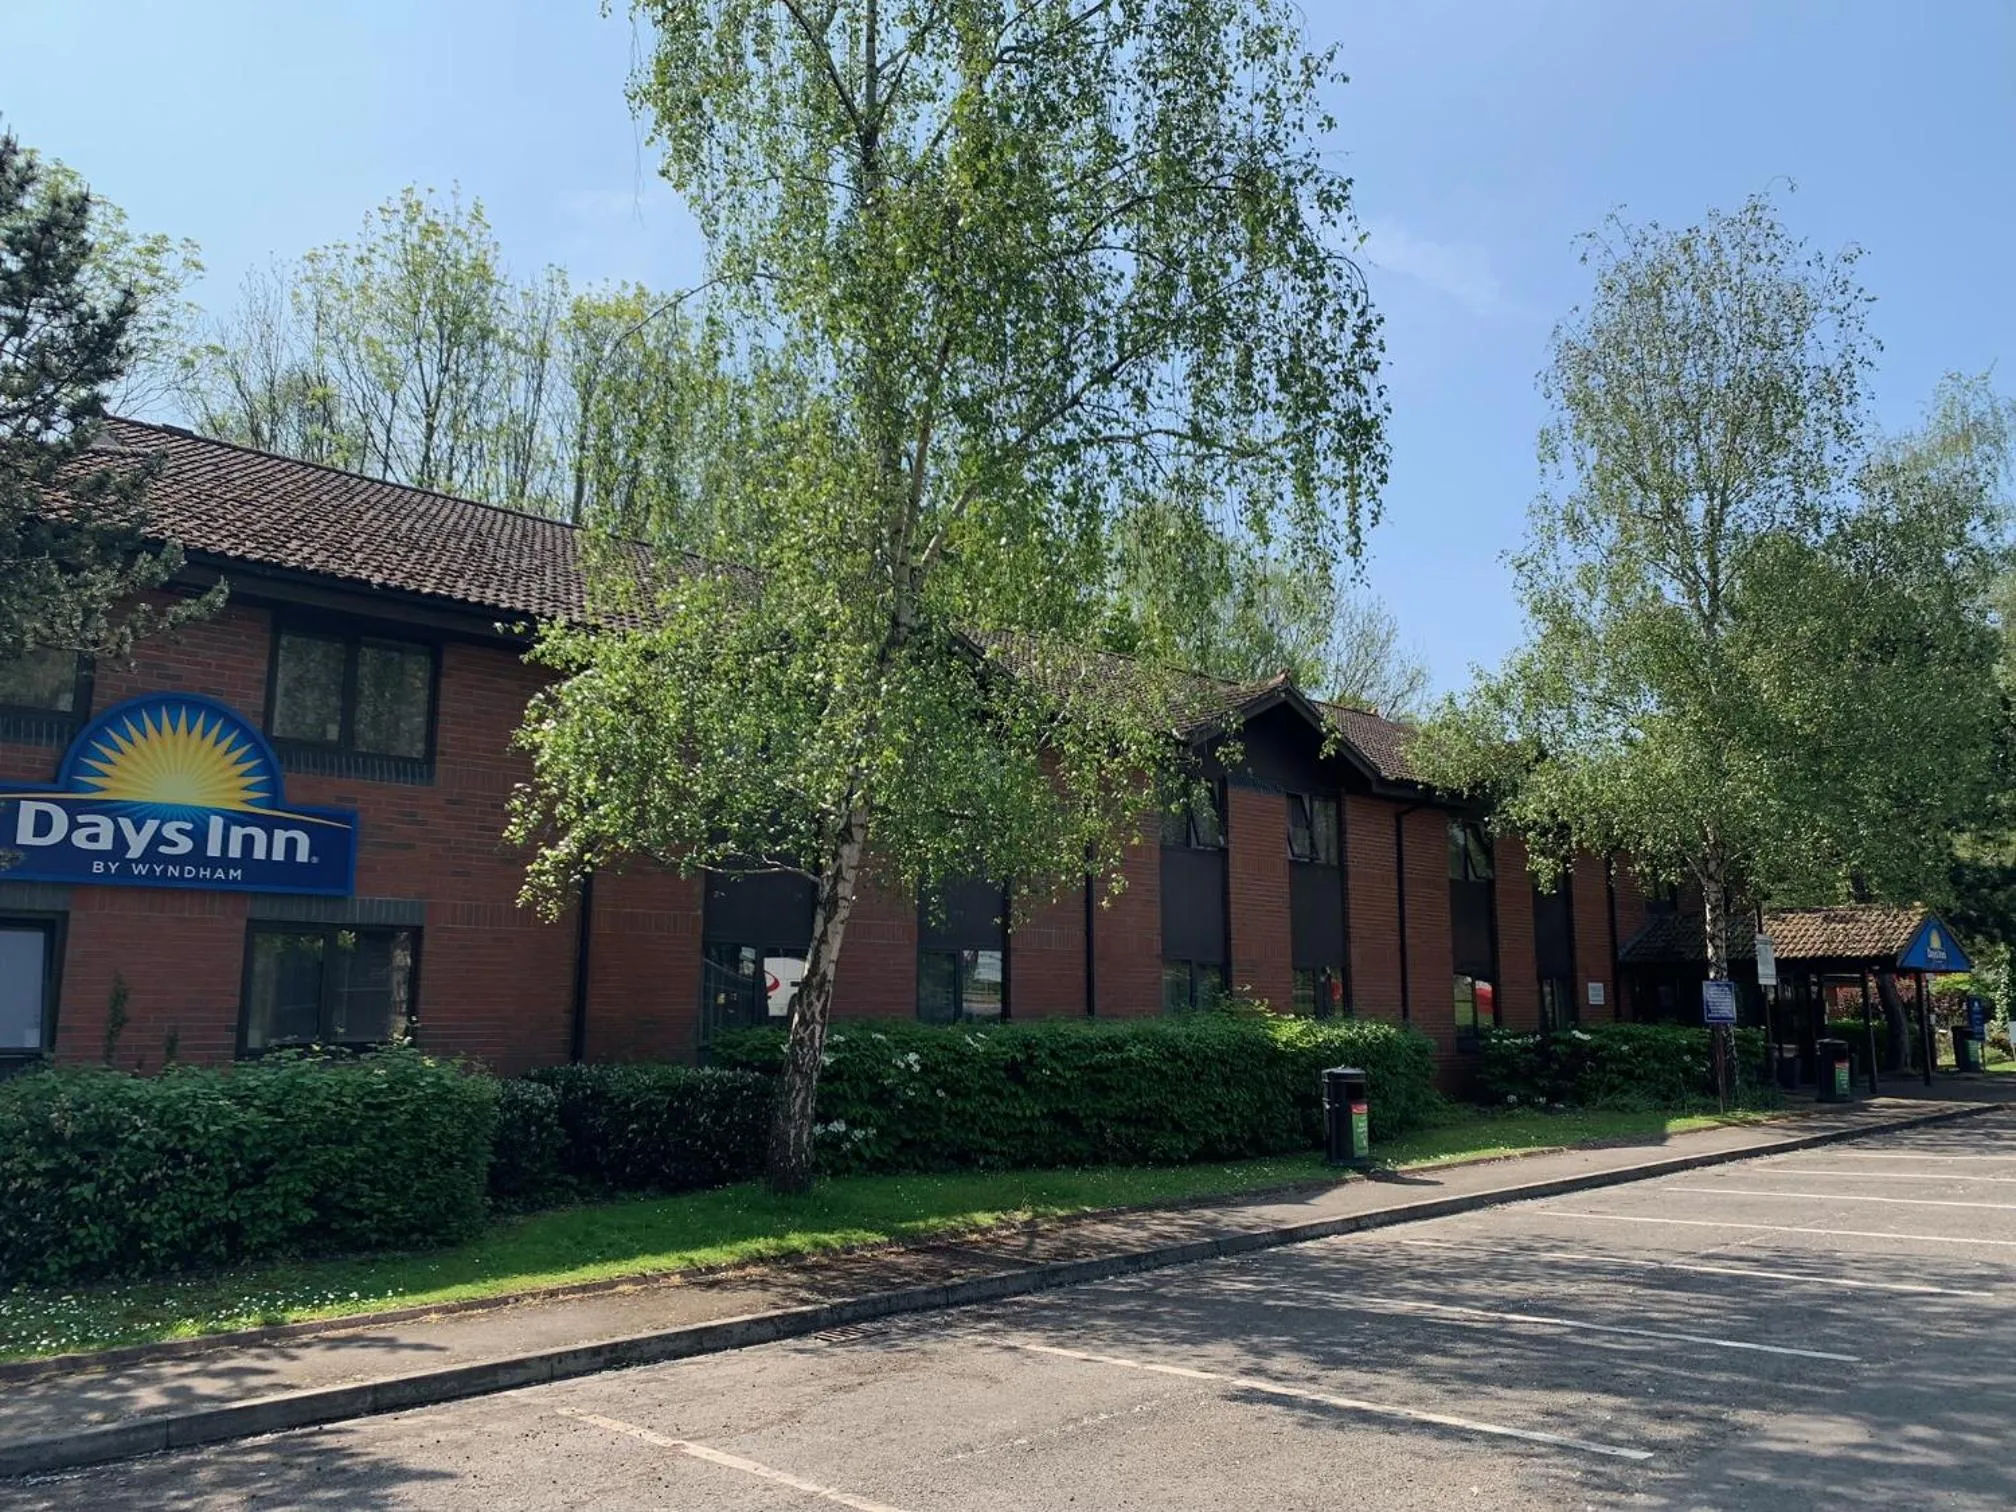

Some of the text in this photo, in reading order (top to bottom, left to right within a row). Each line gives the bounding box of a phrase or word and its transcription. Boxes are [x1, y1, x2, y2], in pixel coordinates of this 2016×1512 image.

[15, 800, 310, 863] Days Inn
[92, 860, 243, 881] BY WYNDHAM
